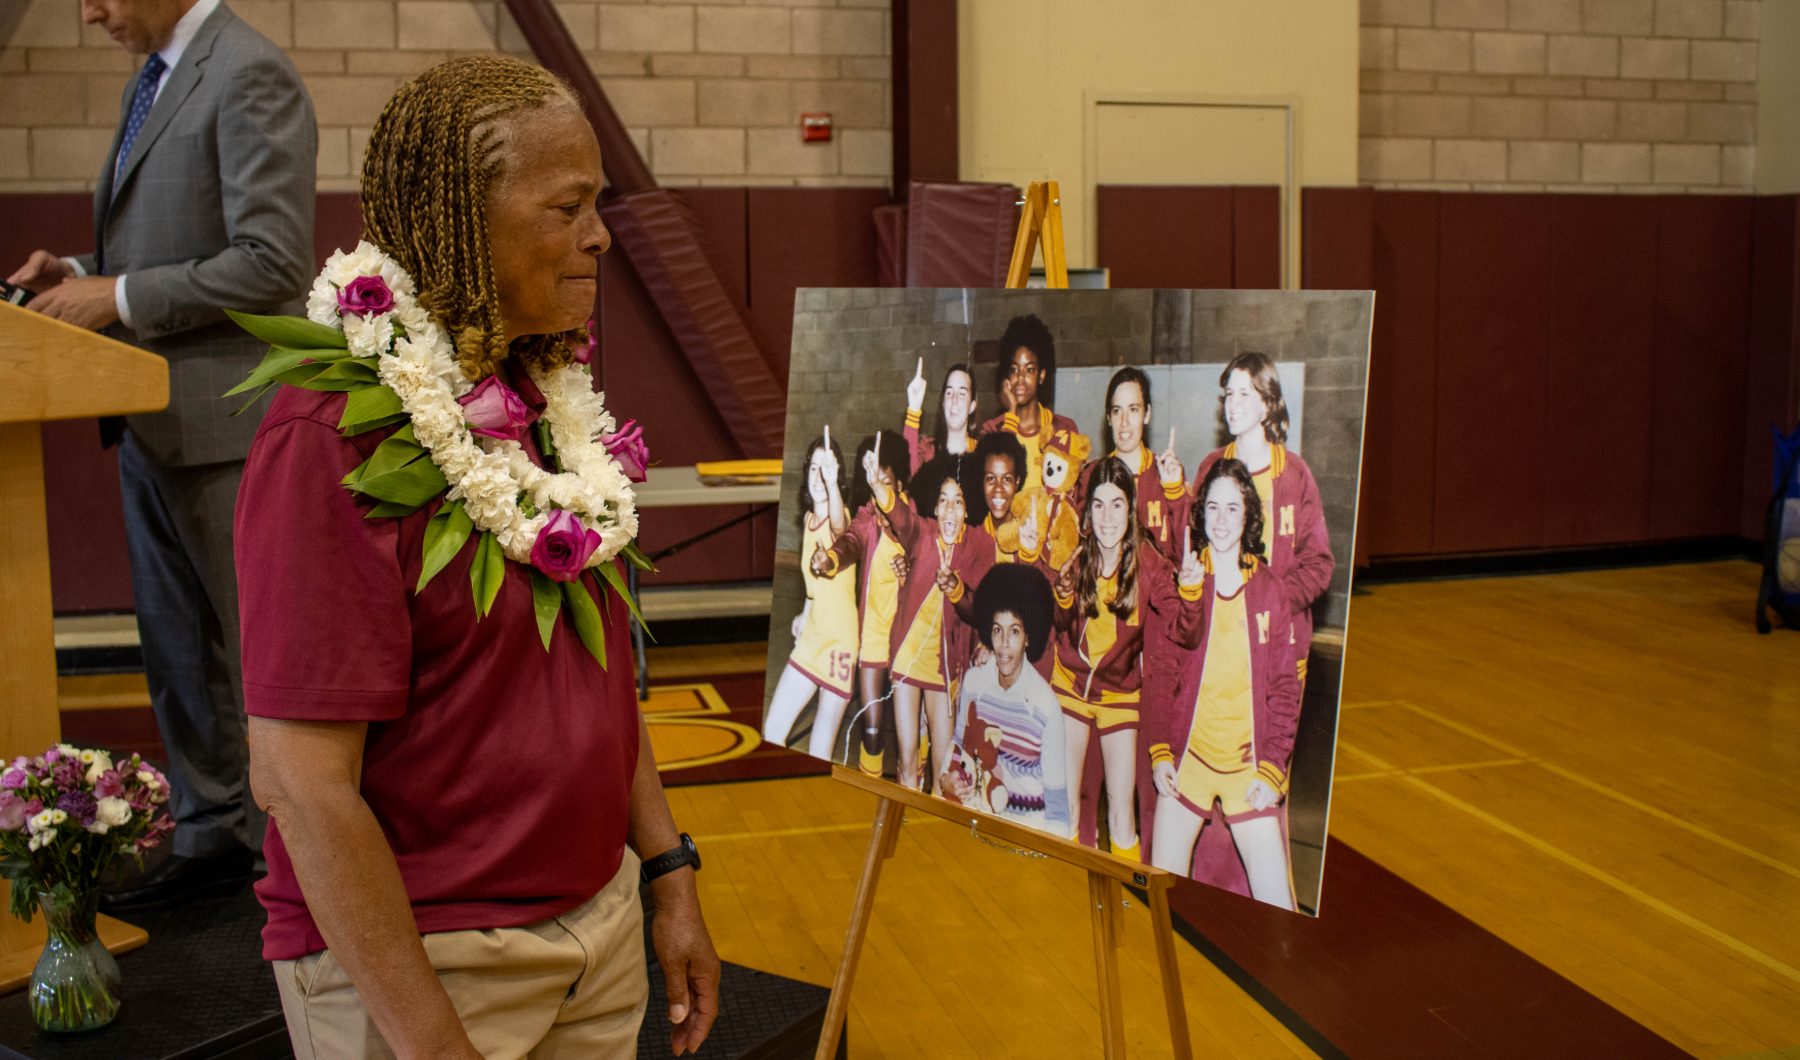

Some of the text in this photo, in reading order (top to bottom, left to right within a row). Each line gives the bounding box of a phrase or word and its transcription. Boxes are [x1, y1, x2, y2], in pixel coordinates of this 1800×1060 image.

[1147, 500, 1162, 527] M
[1279, 504, 1295, 536] M
[829, 650, 851, 682] 15
